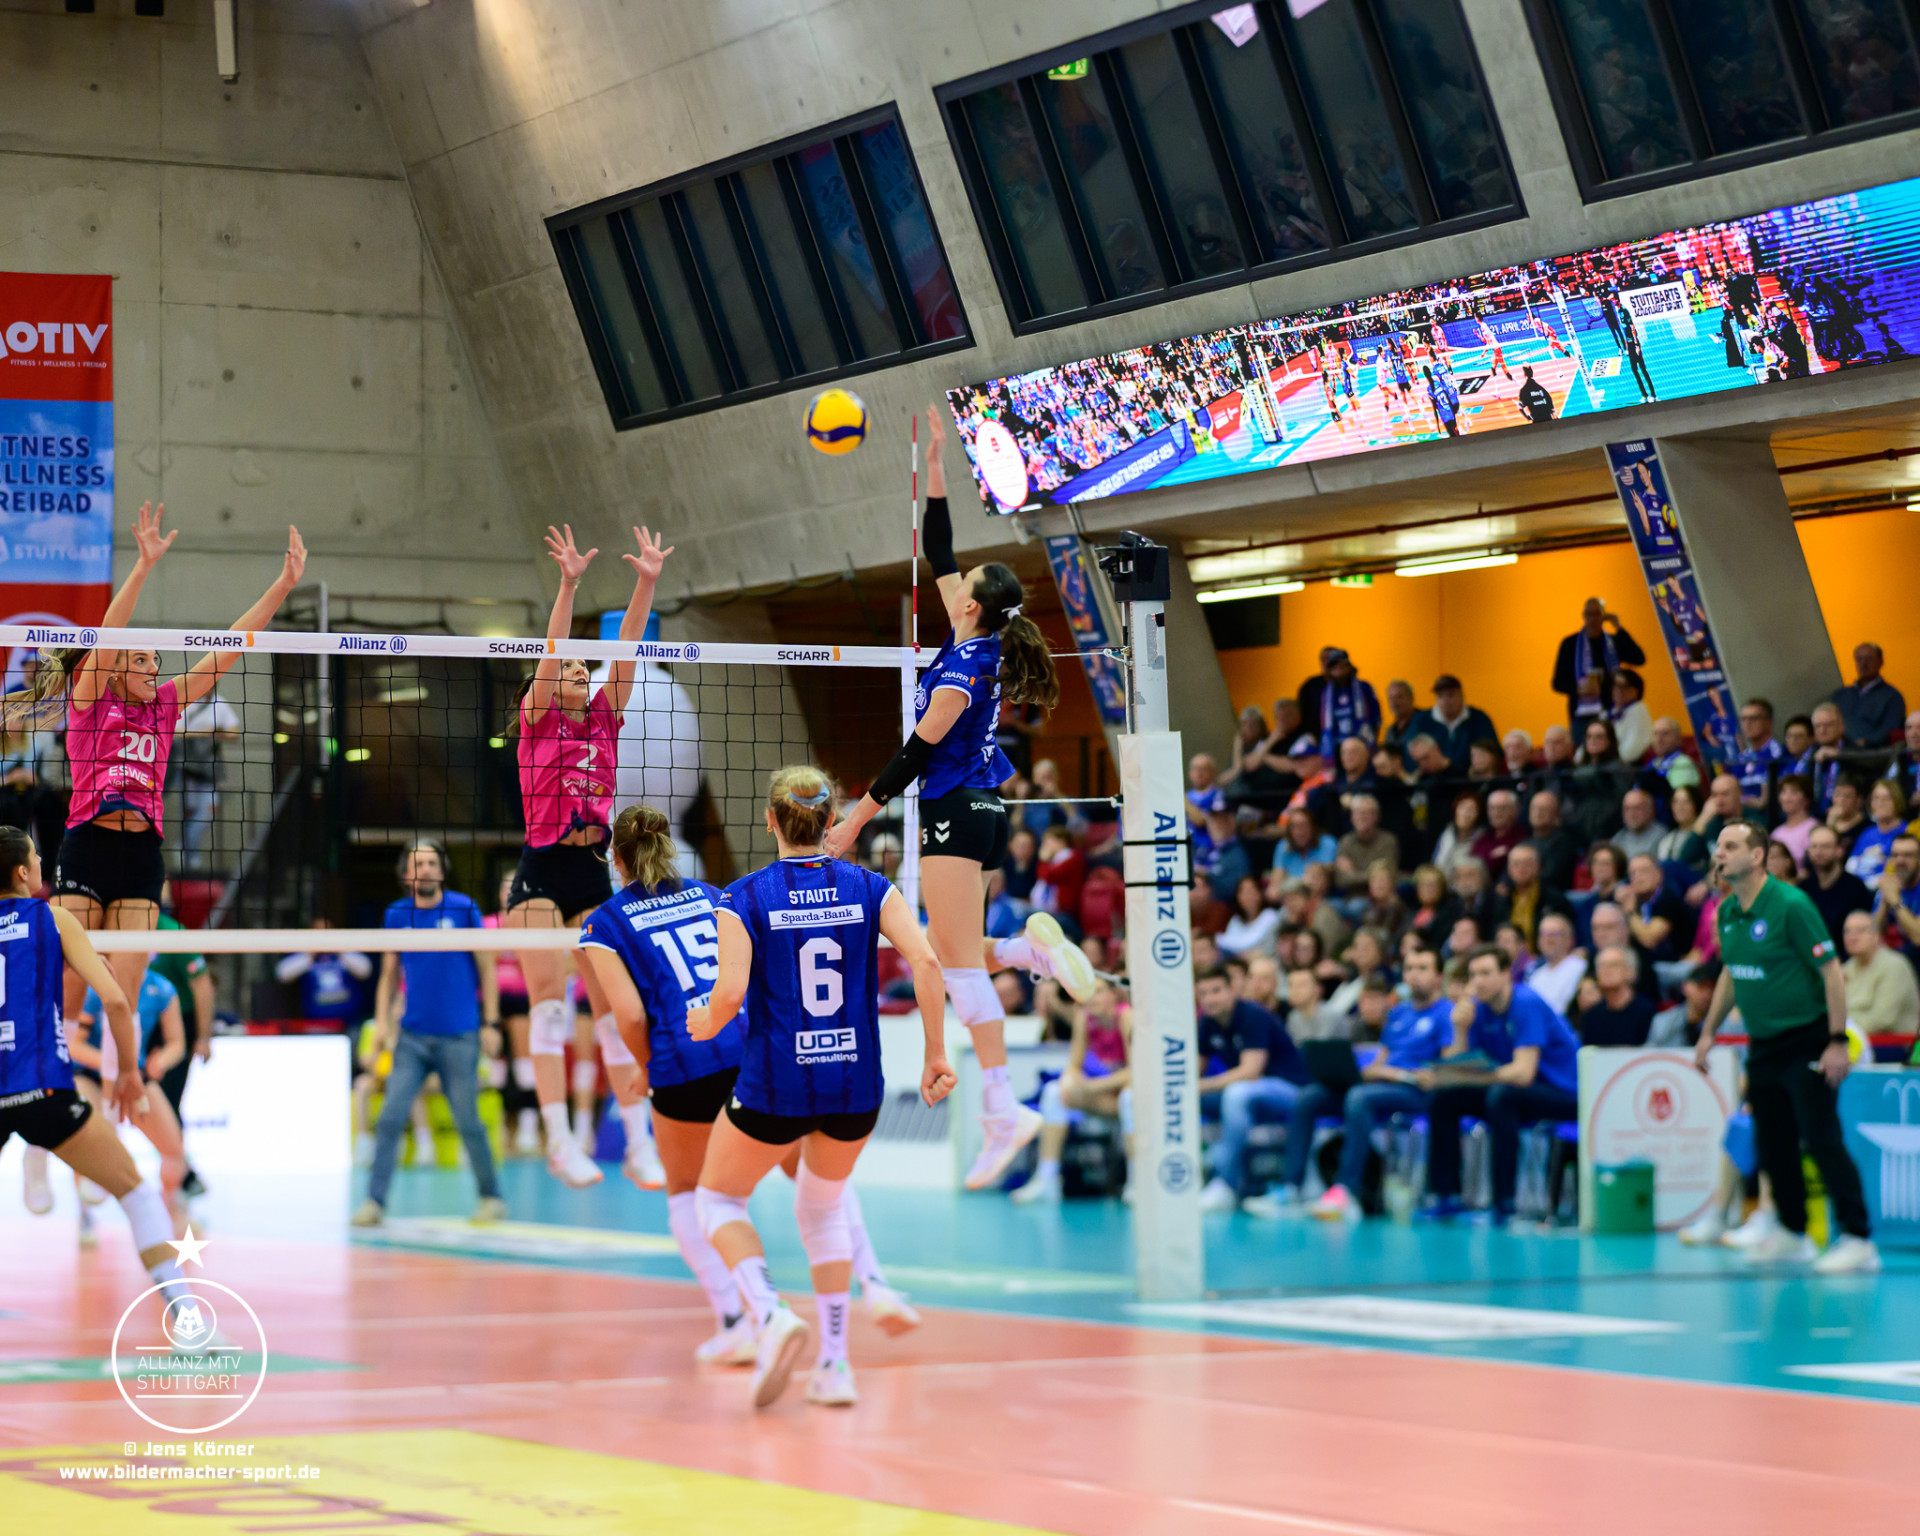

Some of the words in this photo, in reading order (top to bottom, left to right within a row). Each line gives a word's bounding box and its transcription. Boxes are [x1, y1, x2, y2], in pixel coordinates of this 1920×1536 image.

[1629, 287, 1681, 308] STUTTGARTS
[11, 359, 36, 367] FITNESS
[43, 360, 75, 368] WELLNESS
[83, 361, 107, 369] FREIBAD
[2, 435, 90, 458] TNESS
[0, 463, 105, 487] LLNESS
[0, 491, 92, 513] REIBAD
[26, 629, 76, 643] Allianz
[184, 636, 243, 647] SCHARR
[339, 636, 387, 650] Allianz
[488, 642, 544, 654] SCHARR
[635, 644, 680, 658] Allianz
[777, 649, 830, 661] SCHARR
[117, 731, 157, 763] 20
[576, 744, 599, 771] 2
[108, 765, 149, 786] ESWE
[1152, 811, 1177, 922] Allianz
[622, 887, 705, 915] SHAFFMASTER
[788, 887, 839, 904] STAUTZ
[641, 904, 703, 924] Sparda-Bank
[781, 908, 854, 925] Sparda-Bank
[650, 919, 719, 992] 15
[799, 937, 844, 1017] 6
[799, 1032, 852, 1050] UDF
[796, 1053, 858, 1065] Consulting
[1163, 1035, 1185, 1145] Allianz
